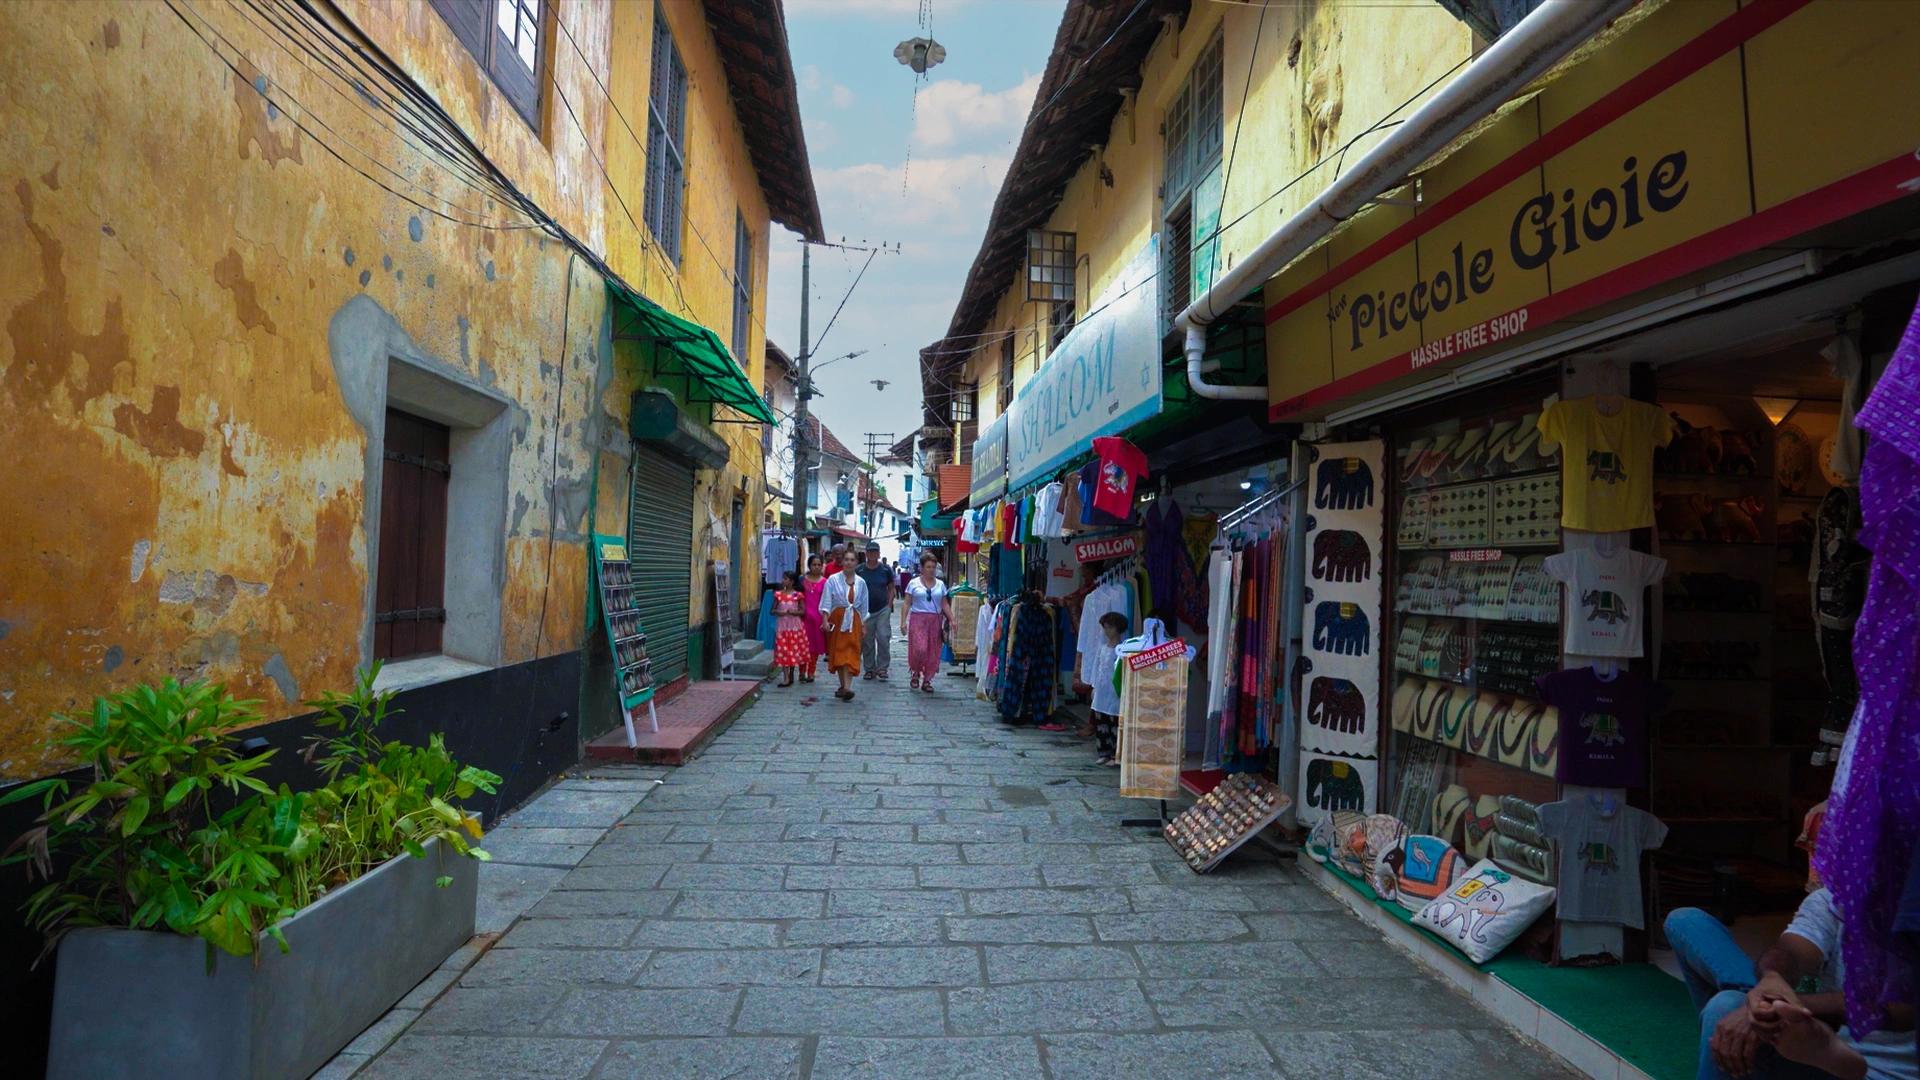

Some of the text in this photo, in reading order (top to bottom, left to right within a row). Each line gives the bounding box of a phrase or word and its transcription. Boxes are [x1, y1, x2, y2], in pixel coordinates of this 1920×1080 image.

[1350, 150, 1690, 351] Piccole Gioie
[1411, 308, 1529, 369] HASSLE FREE SHOP
[1019, 321, 1116, 463] SHALOM
[1079, 538, 1135, 559] SHALOM
[1449, 549, 1502, 561] HASSLE FREE SHOP
[1131, 640, 1183, 665] KERALA SAREES
